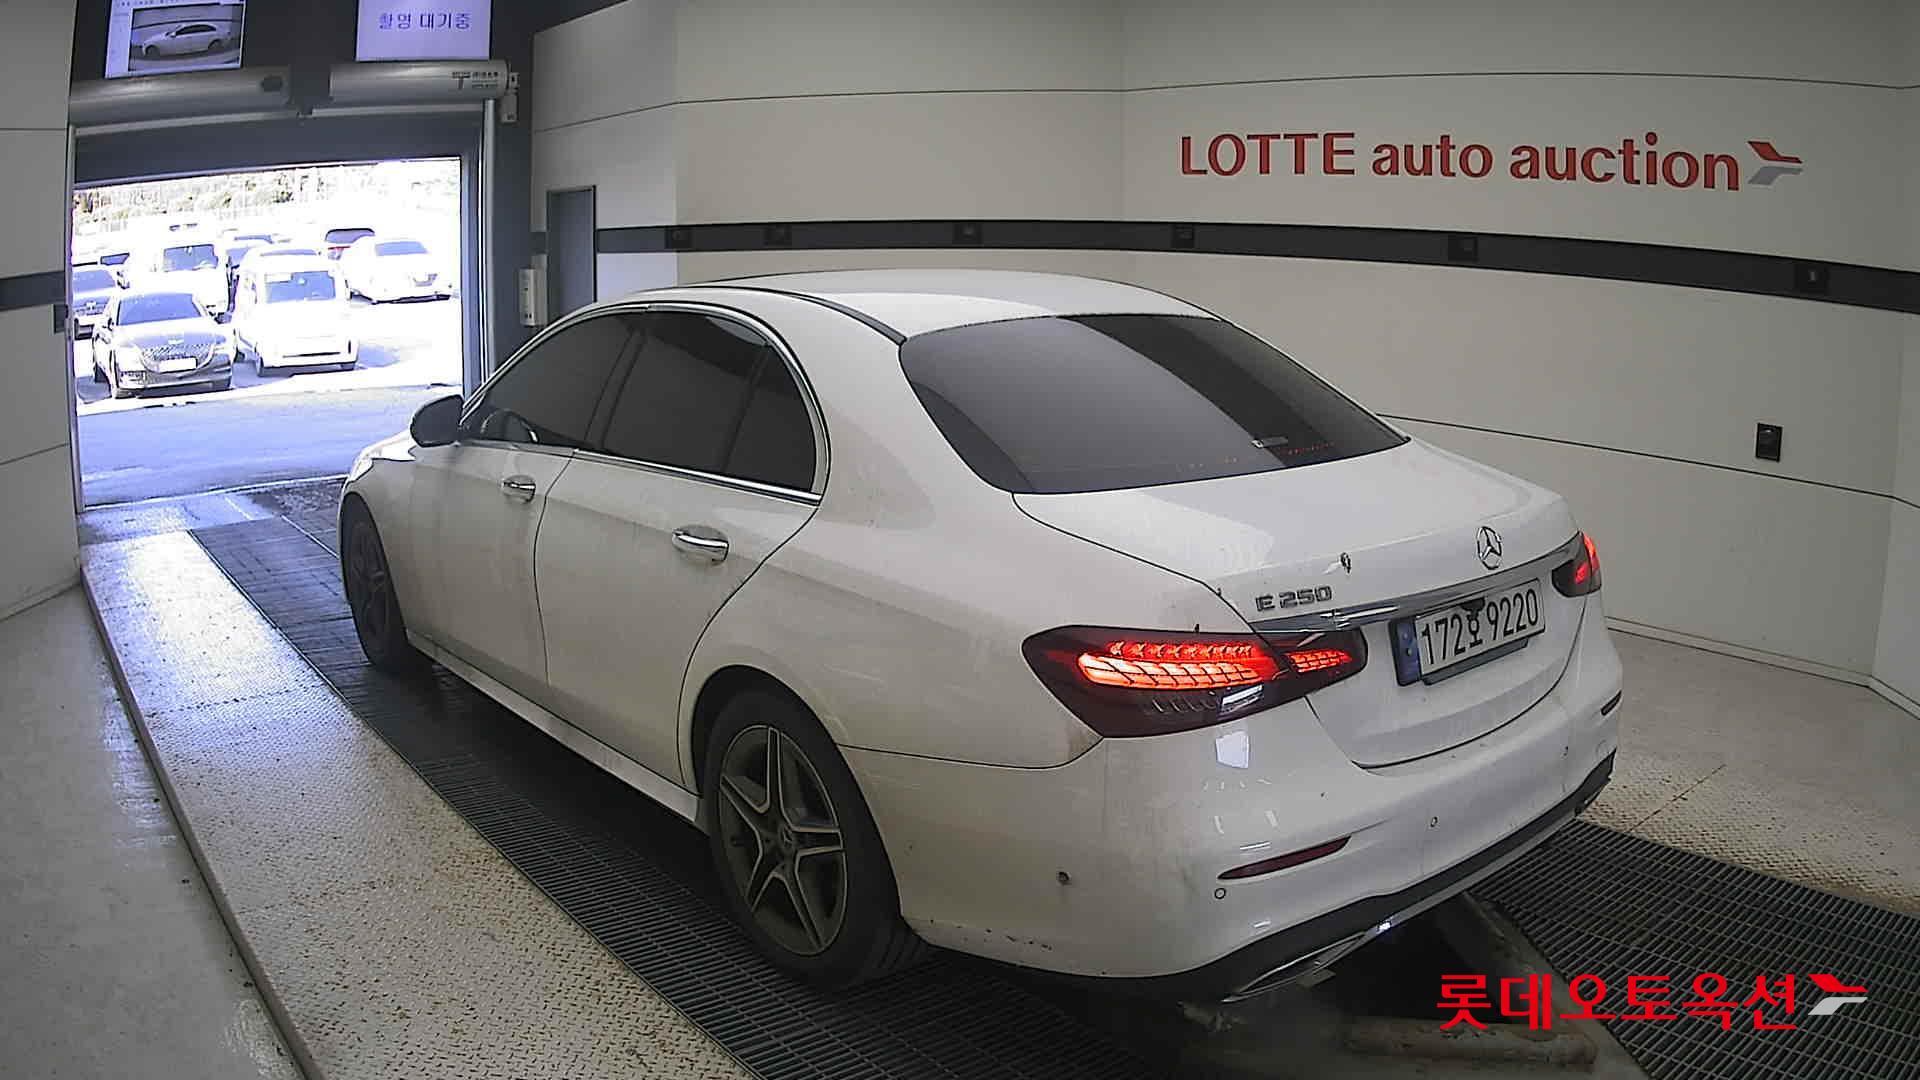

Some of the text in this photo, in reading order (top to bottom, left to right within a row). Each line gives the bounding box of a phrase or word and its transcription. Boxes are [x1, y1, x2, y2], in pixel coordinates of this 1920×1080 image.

[419, 12, 471, 31] 대기중
[1180, 131, 1741, 192] LOTTE auto auction
[1255, 585, 1333, 612] E 250
